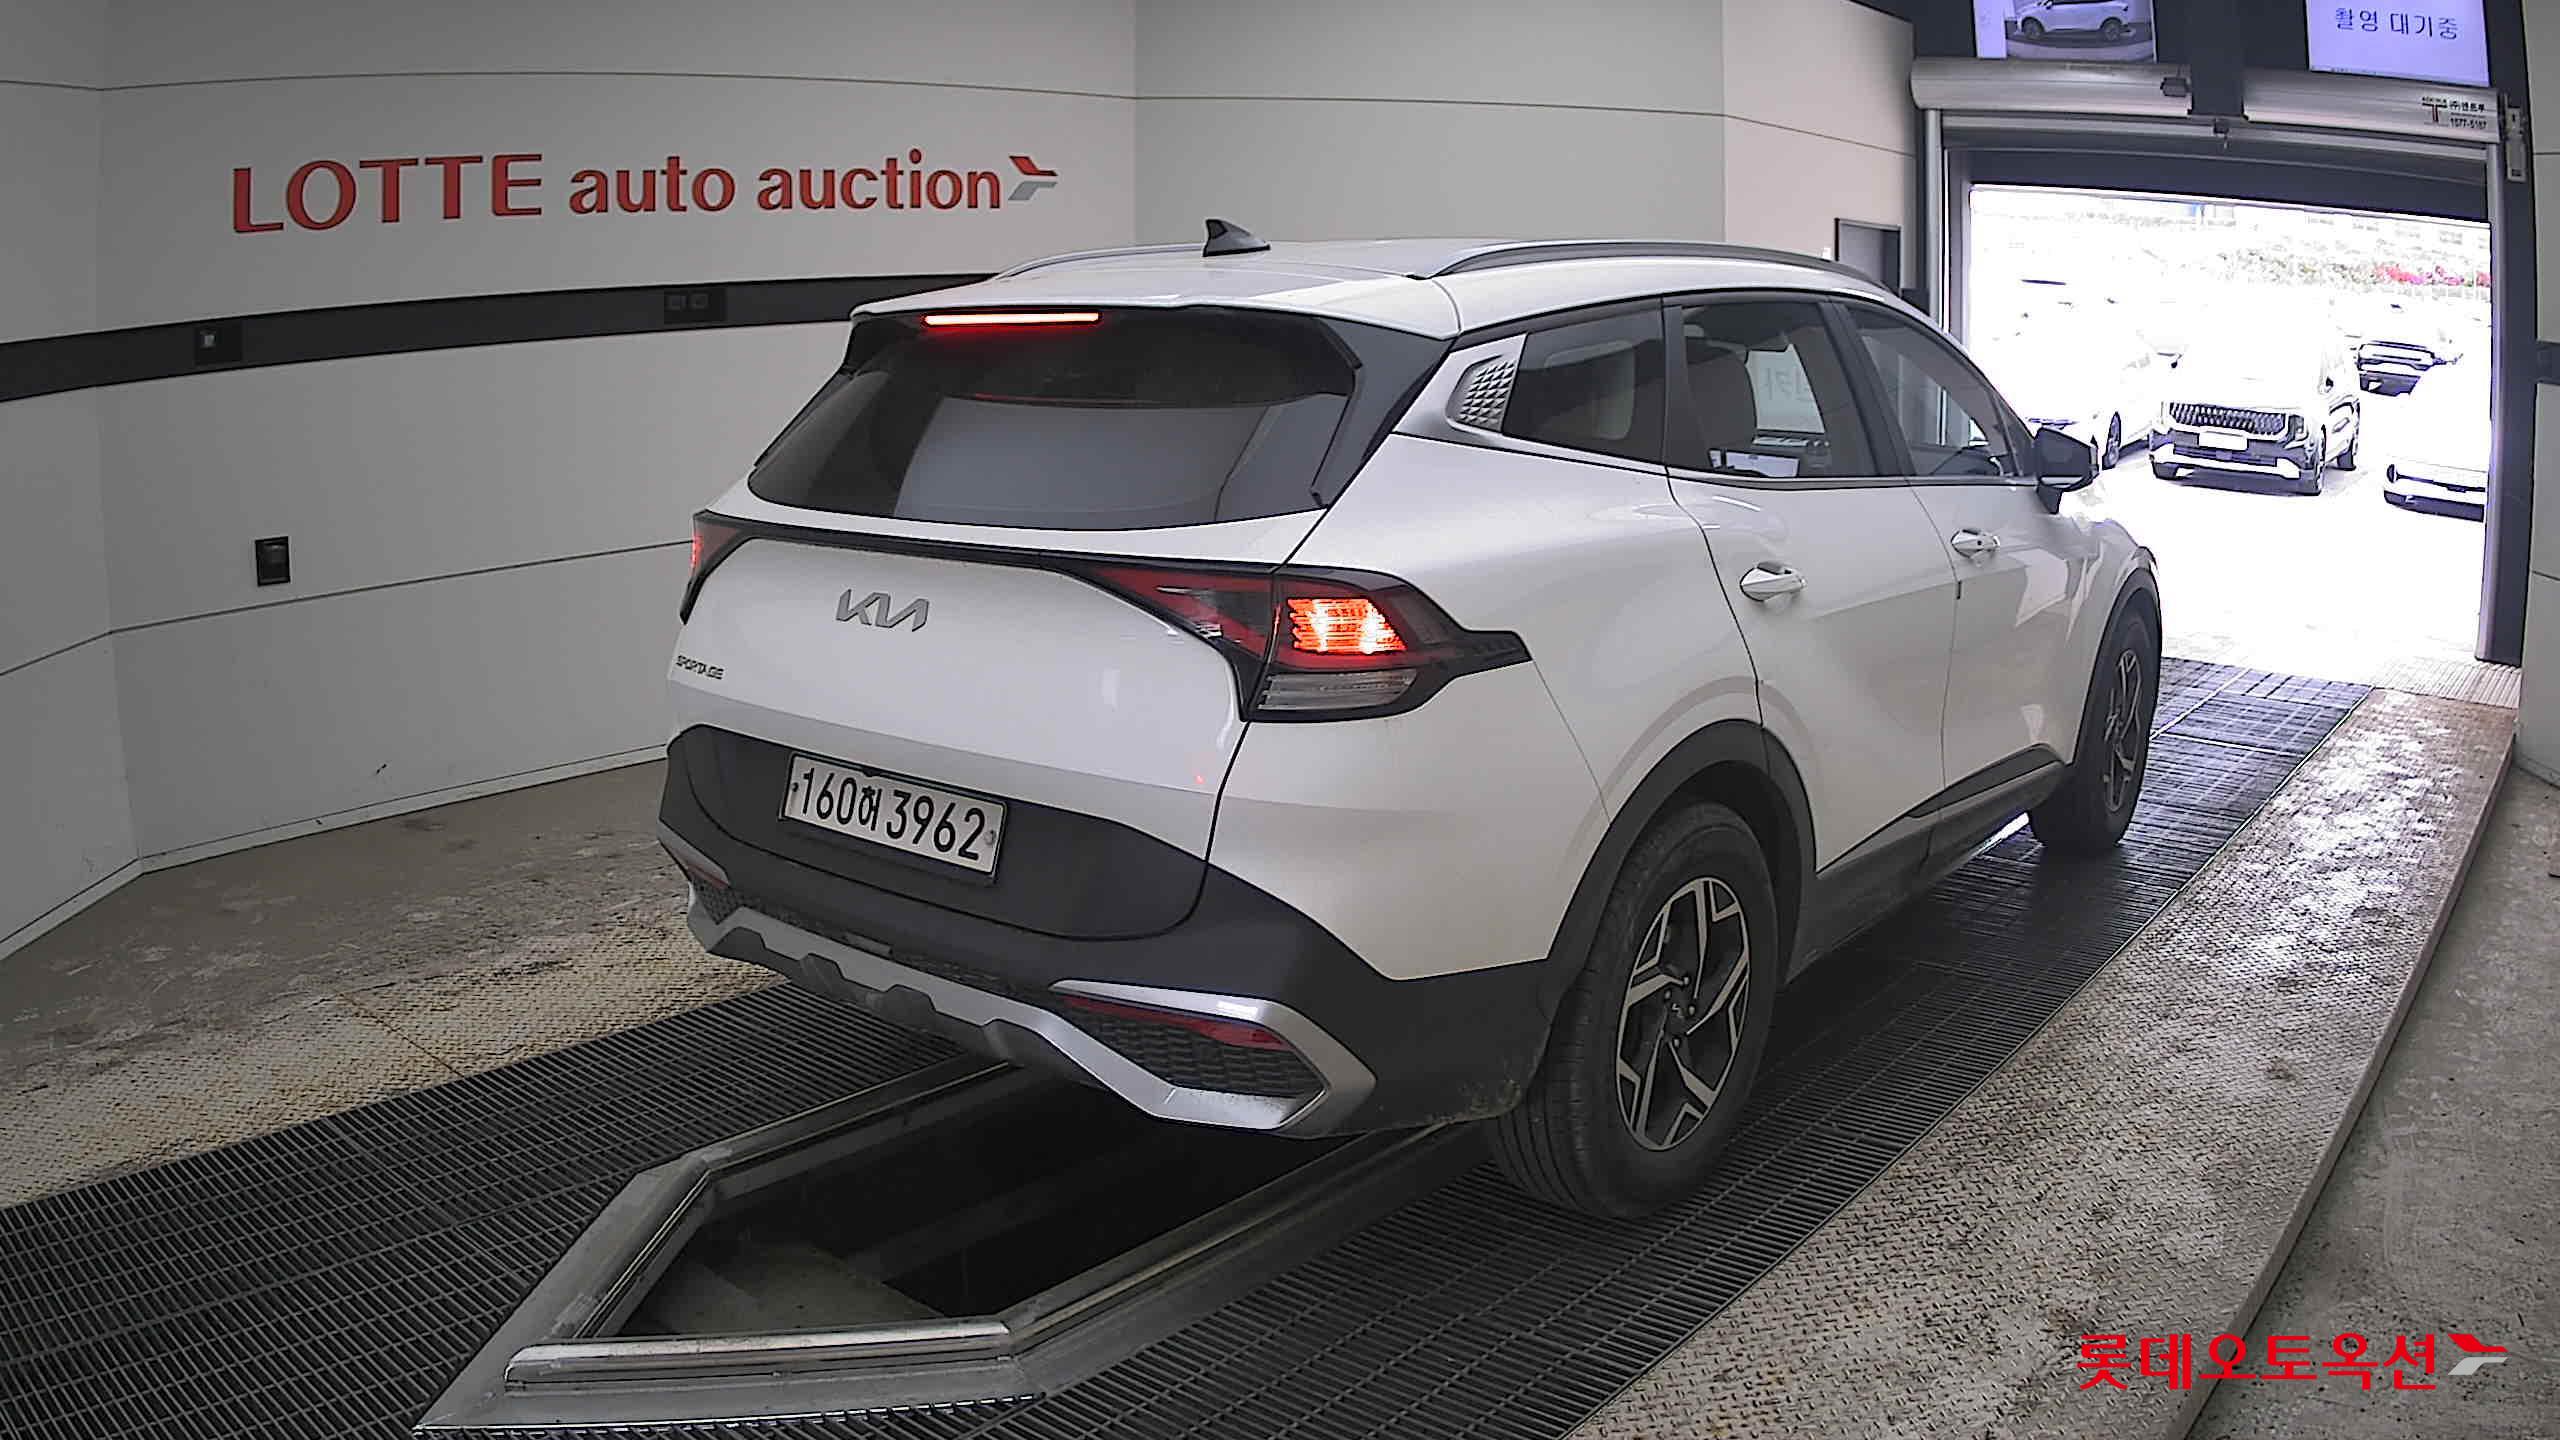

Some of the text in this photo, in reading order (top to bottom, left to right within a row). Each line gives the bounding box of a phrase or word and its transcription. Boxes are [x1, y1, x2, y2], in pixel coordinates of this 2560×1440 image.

[2336, 7, 2459, 40] 촬영 대기중
[234, 150, 1002, 233] LOTTE auto auction
[836, 588, 930, 632] KIA
[676, 655, 724, 680] SPORTAGE
